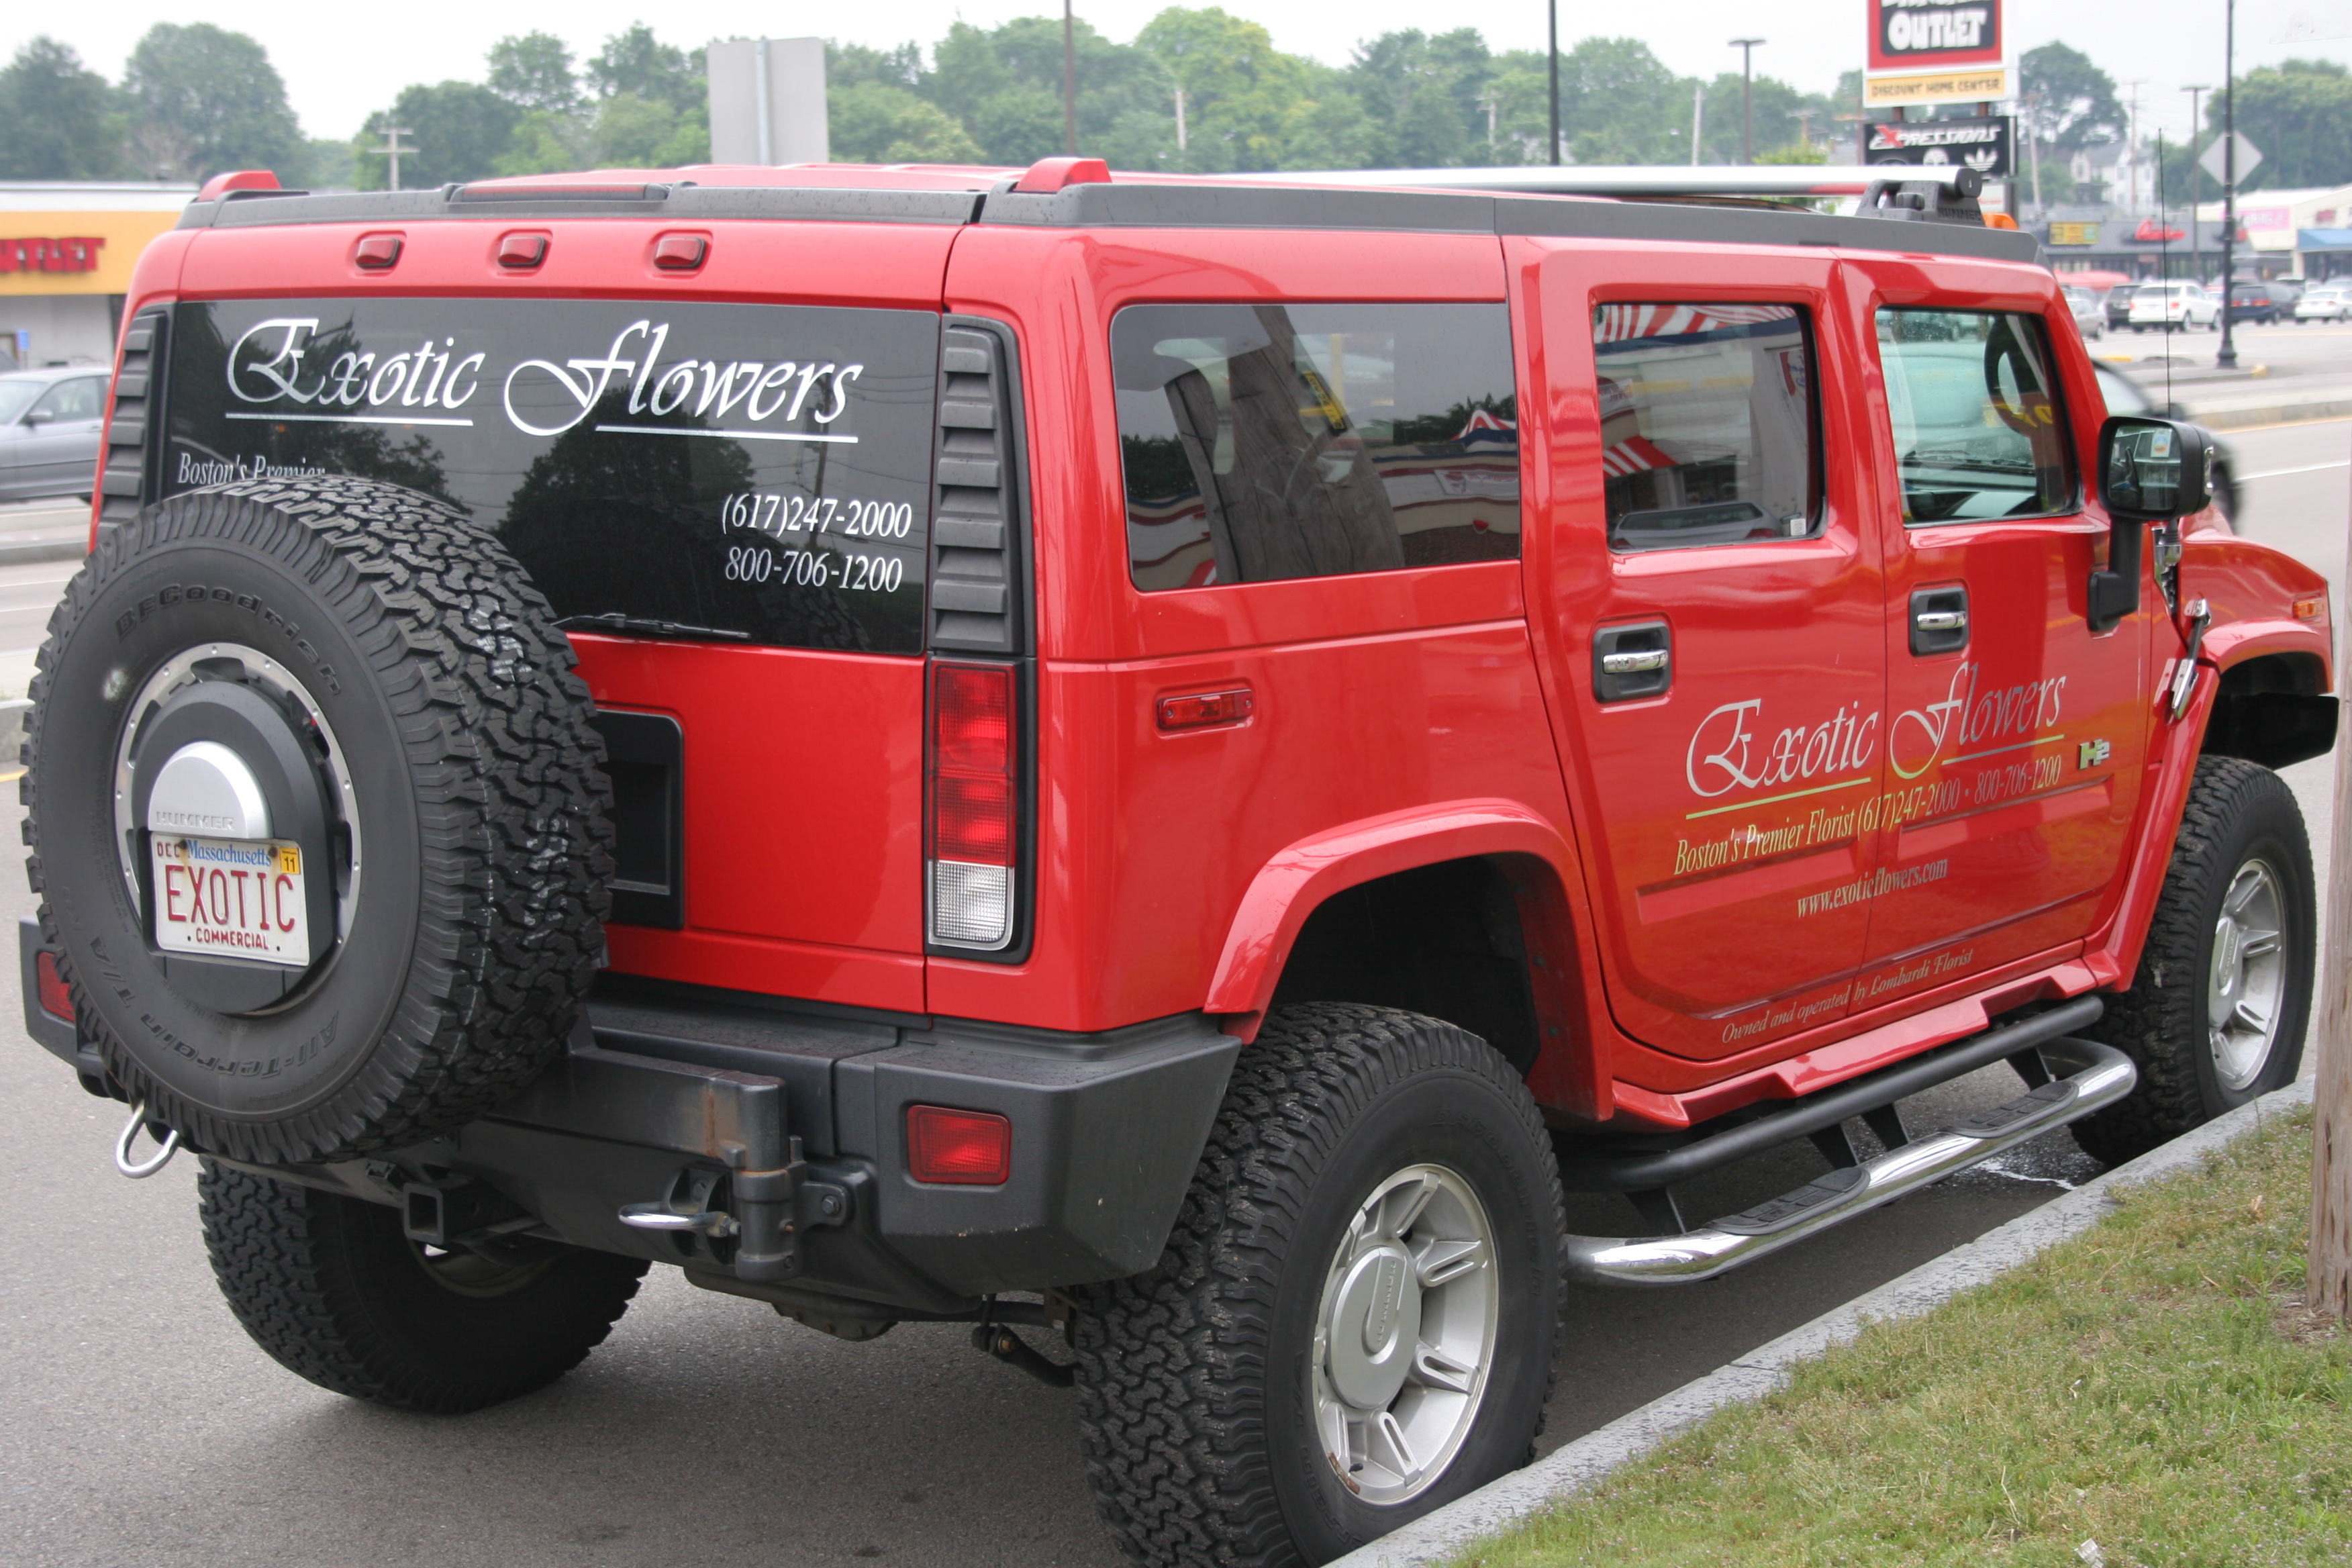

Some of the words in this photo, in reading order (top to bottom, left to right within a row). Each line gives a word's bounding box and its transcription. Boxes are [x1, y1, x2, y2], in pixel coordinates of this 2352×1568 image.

[1888, 9, 1987, 50] OUTLET
[1872, 83, 1923, 97] DISCOUNT
[1926, 81, 1954, 93] HOME
[1957, 79, 2000, 92] CENTER
[227, 318, 486, 409] Exotic
[503, 320, 864, 436] Flowers
[177, 452, 247, 484] Boston's
[722, 493, 912, 538] (617)247-2000
[725, 546, 903, 593] 800-706-1200
[115, 584, 342, 696] BFGoodrich
[1686, 698, 1879, 797] Exotic
[1890, 661, 2066, 779] Flowers
[2078, 739, 2110, 770] H2
[156, 811, 235, 831] HUMMER
[1673, 828, 1740, 875] Boston's
[1743, 817, 1805, 860] Premier
[1807, 805, 1856, 848] Florist
[1857, 778, 1960, 837] (617)247-2000
[1974, 754, 2062, 805] 800-706-1200
[157, 841, 181, 857] DEC
[187, 839, 272, 867] Massachusetts
[284, 856, 295, 873] 11
[165, 864, 295, 932] EXOTIC
[1797, 858, 1949, 919] www.exoticflowers.com
[196, 928, 270, 950] COMMERCIAL
[1722, 1016, 1769, 1044] Owned
[1771, 1009, 1796, 1031] and
[1797, 984, 1851, 1024] operated
[1853, 981, 1869, 1005] by
[1870, 960, 1930, 996] Lombardi
[1934, 948, 1974, 975] Florist
